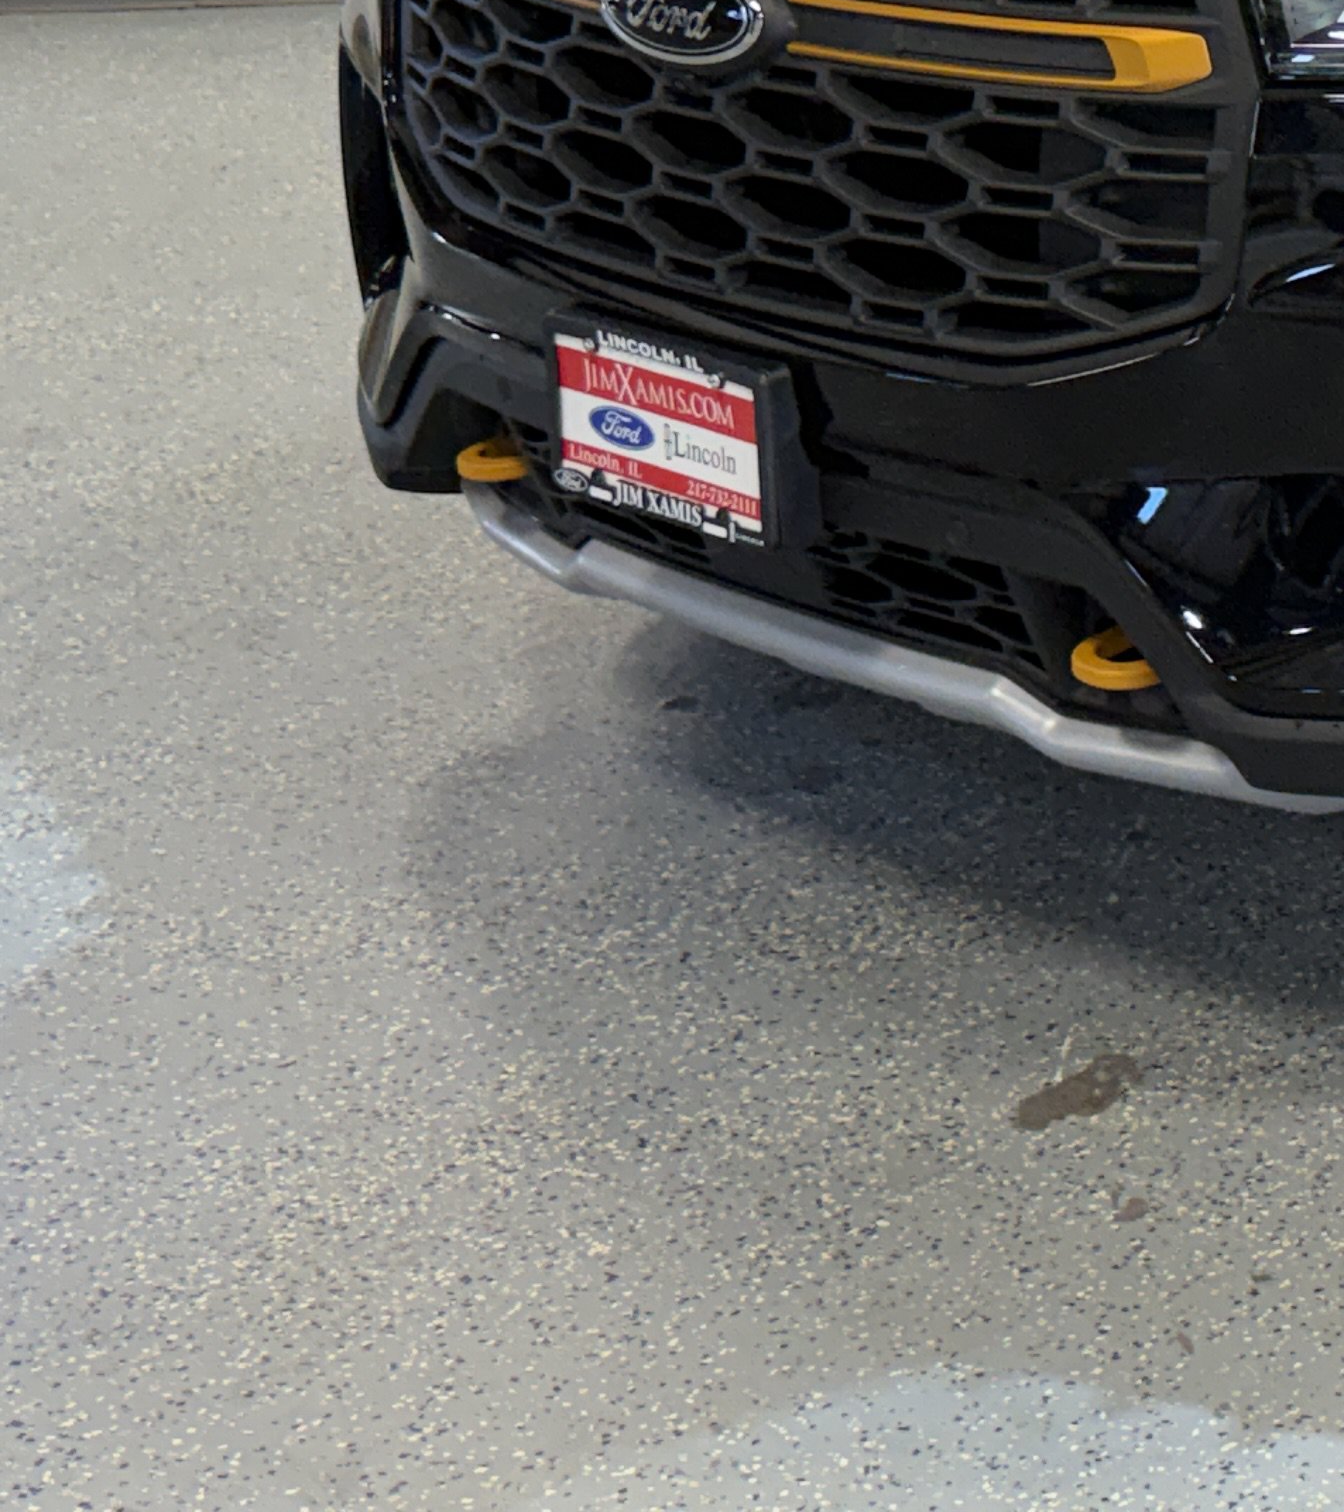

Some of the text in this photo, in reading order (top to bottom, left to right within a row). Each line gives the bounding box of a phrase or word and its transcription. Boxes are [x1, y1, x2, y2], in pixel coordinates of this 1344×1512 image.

[684, 354, 704, 373] IL
[601, 409, 641, 445] Ford
[627, 460, 643, 479] IL
[673, 430, 737, 475] Lincoln
[612, 479, 702, 527] JIM XAMIS
